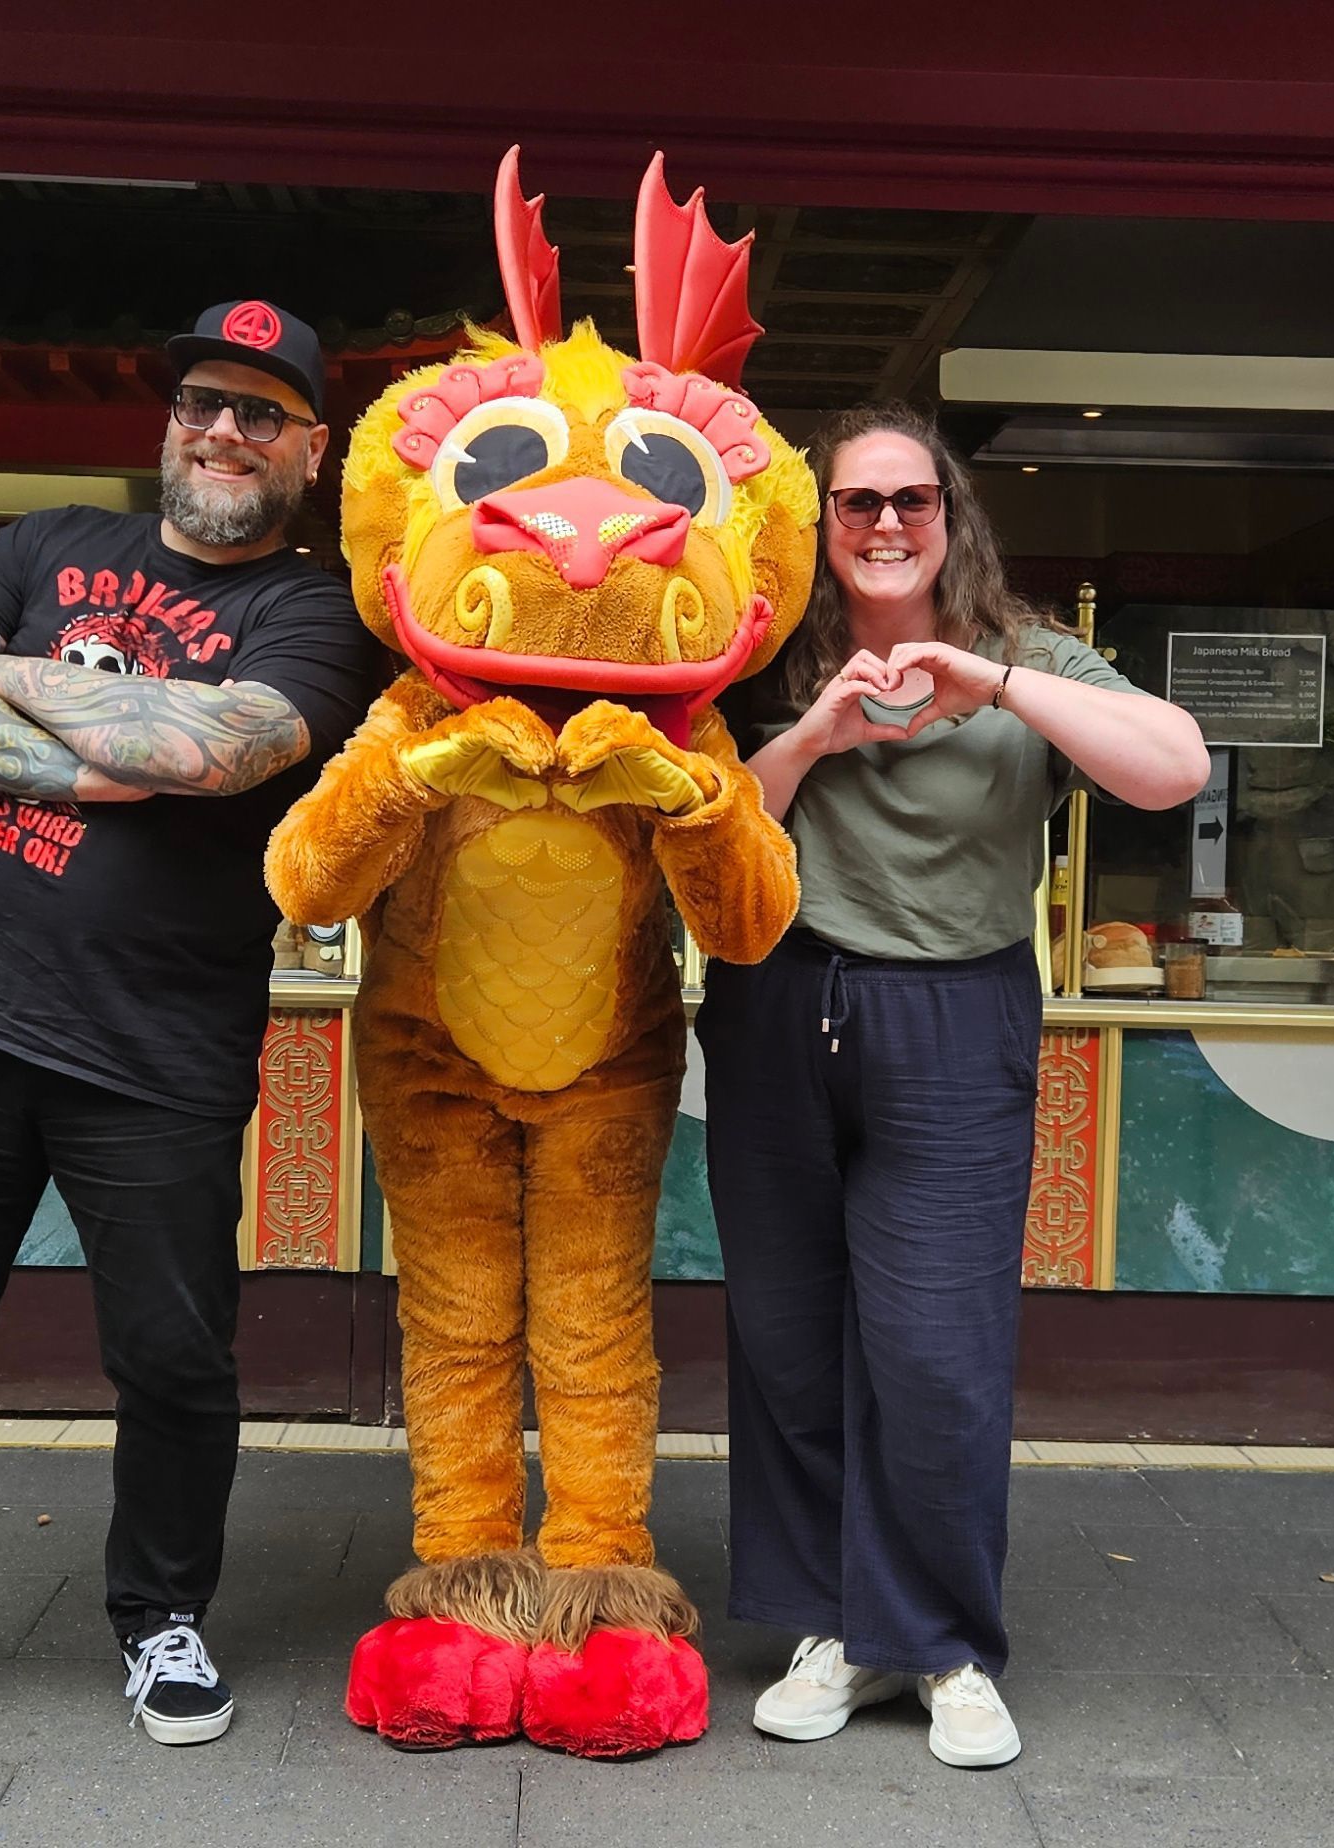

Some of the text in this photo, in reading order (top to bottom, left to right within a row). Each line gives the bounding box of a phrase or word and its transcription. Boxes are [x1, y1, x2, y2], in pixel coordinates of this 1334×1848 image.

[1193, 646, 1291, 658] Japanese Milk Bread
[17, 804, 84, 848] WIRD
[23, 838, 70, 876] OK!
